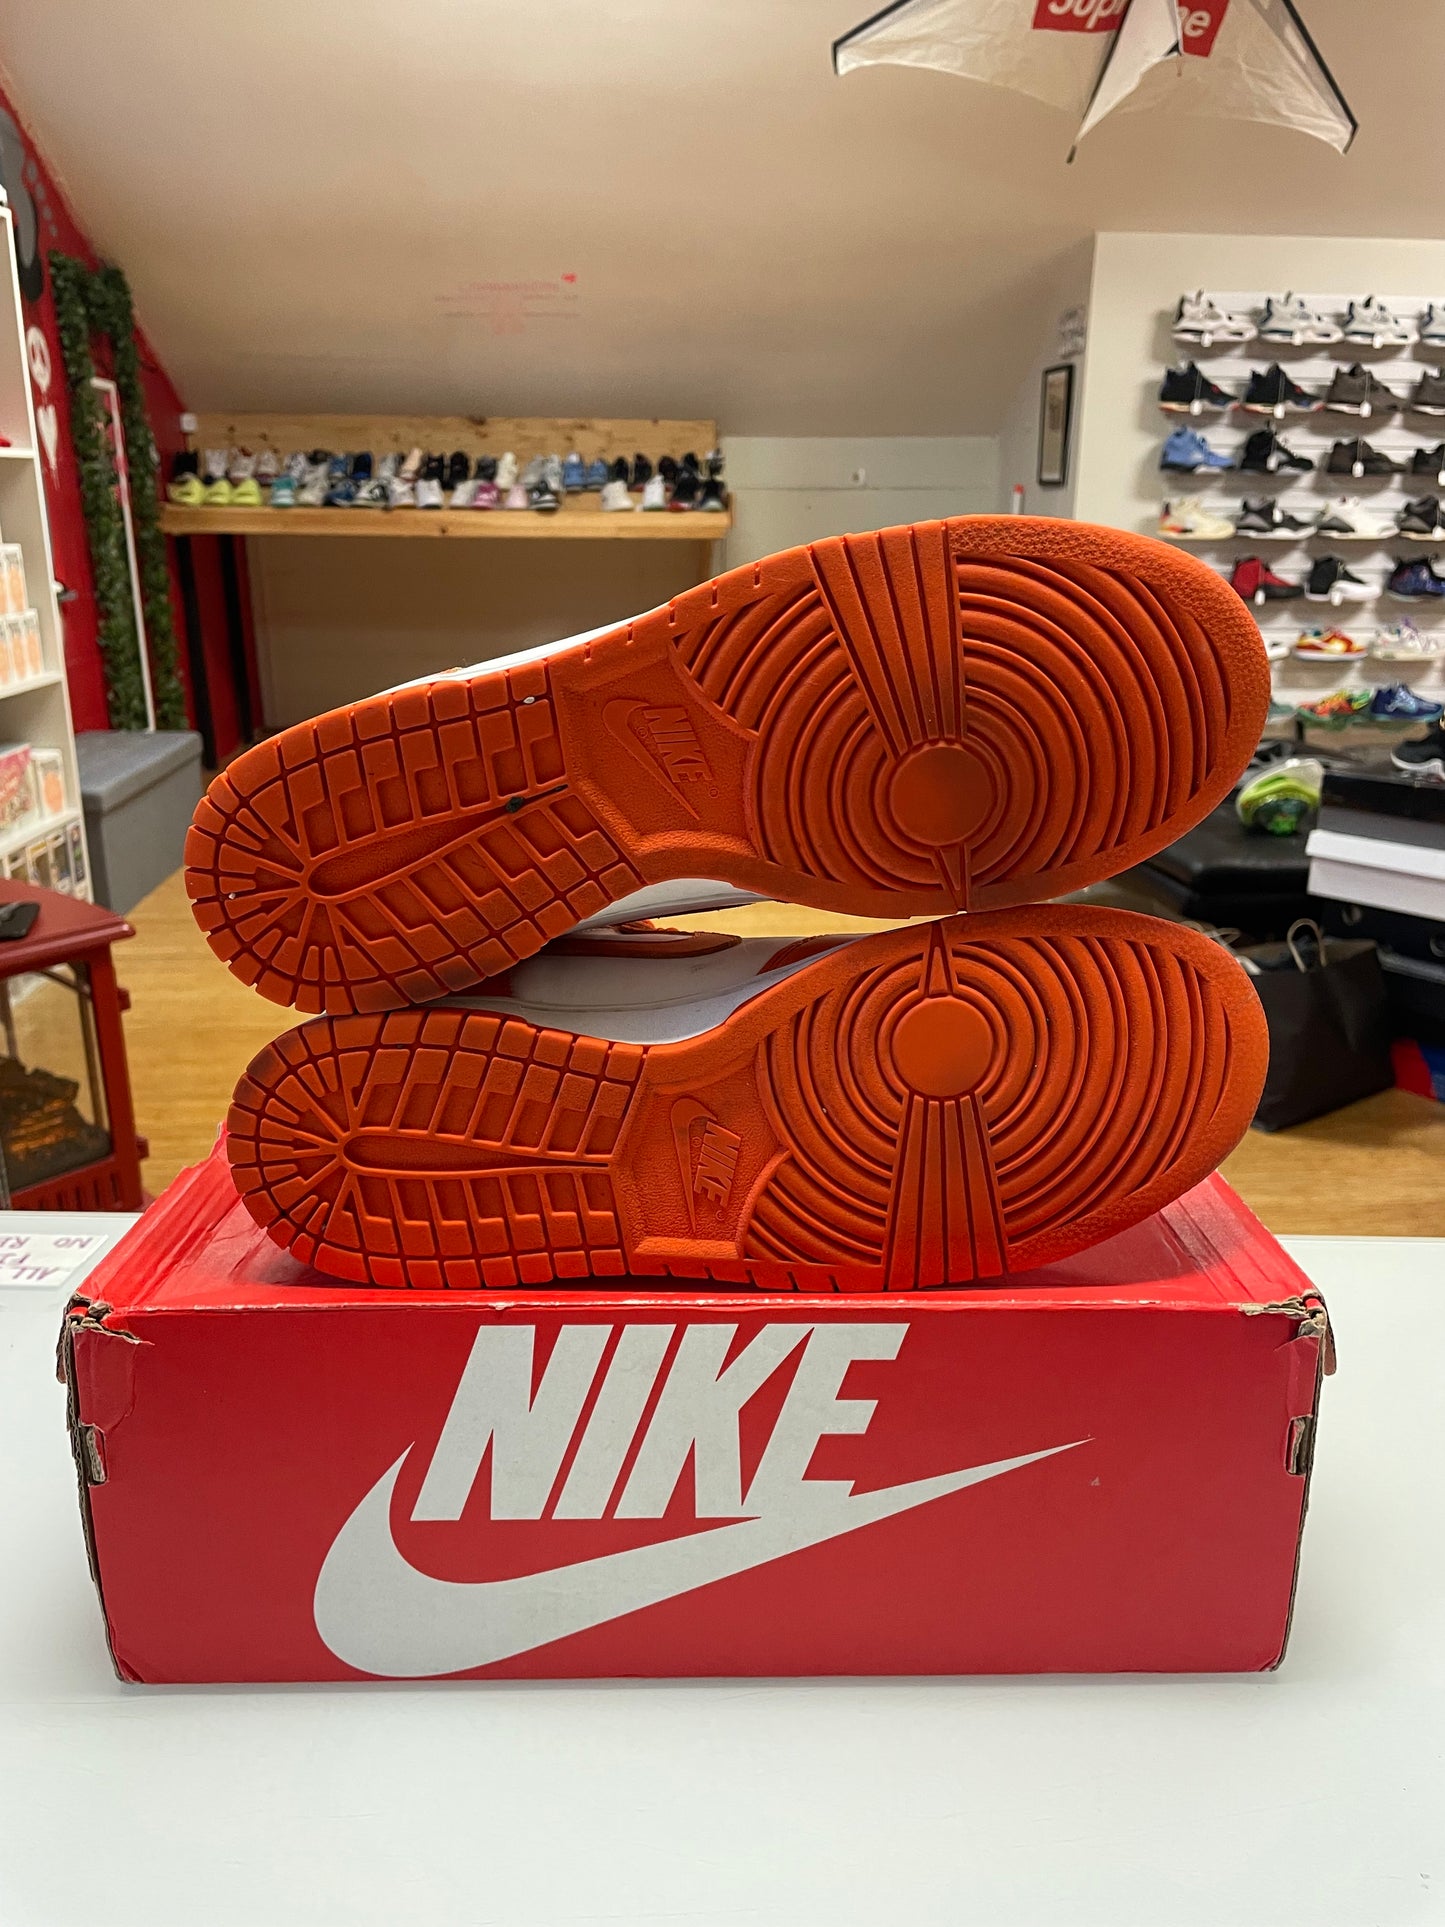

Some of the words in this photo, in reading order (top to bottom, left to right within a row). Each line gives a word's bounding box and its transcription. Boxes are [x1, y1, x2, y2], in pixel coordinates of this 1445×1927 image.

[643, 707, 713, 783] NIKE
[694, 1121, 742, 1208] NIKE
[411, 1323, 909, 1522] NIKE
